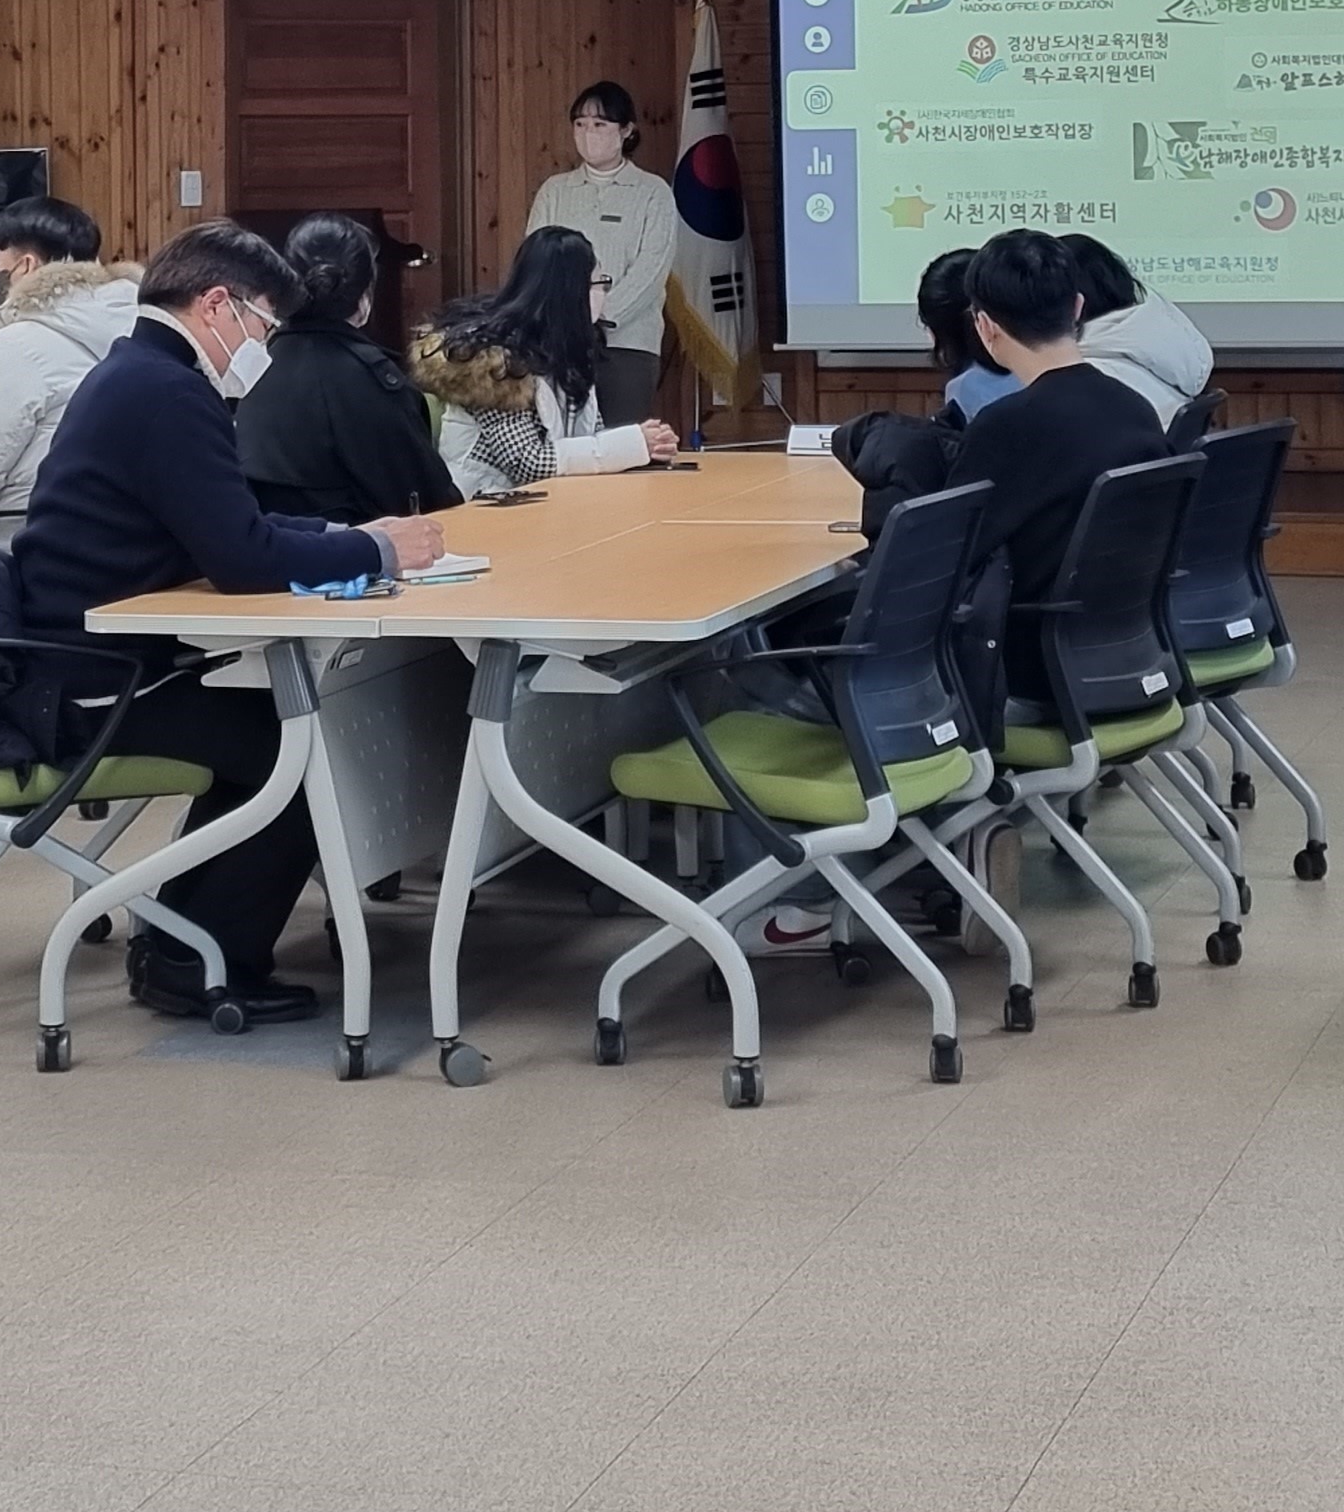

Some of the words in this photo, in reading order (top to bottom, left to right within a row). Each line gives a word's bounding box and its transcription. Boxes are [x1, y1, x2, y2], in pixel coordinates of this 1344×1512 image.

[959, 1, 1003, 12] HADONG
[1005, 1, 1040, 12] OFFICE
[1042, 0, 1057, 11] OF
[1058, 0, 1114, 11] EDUCATION
[1007, 32, 1170, 52] 경상남도사천교육지원청
[1058, 52, 1094, 63] OFFICE
[1096, 51, 1108, 62] OF
[1111, 50, 1168, 62] EDUCATION
[1022, 65, 1156, 85] 특수교육지원센터
[916, 123, 1094, 141] 사천시장애인보호작업장
[943, 202, 1117, 225] 사천지역자활센터
